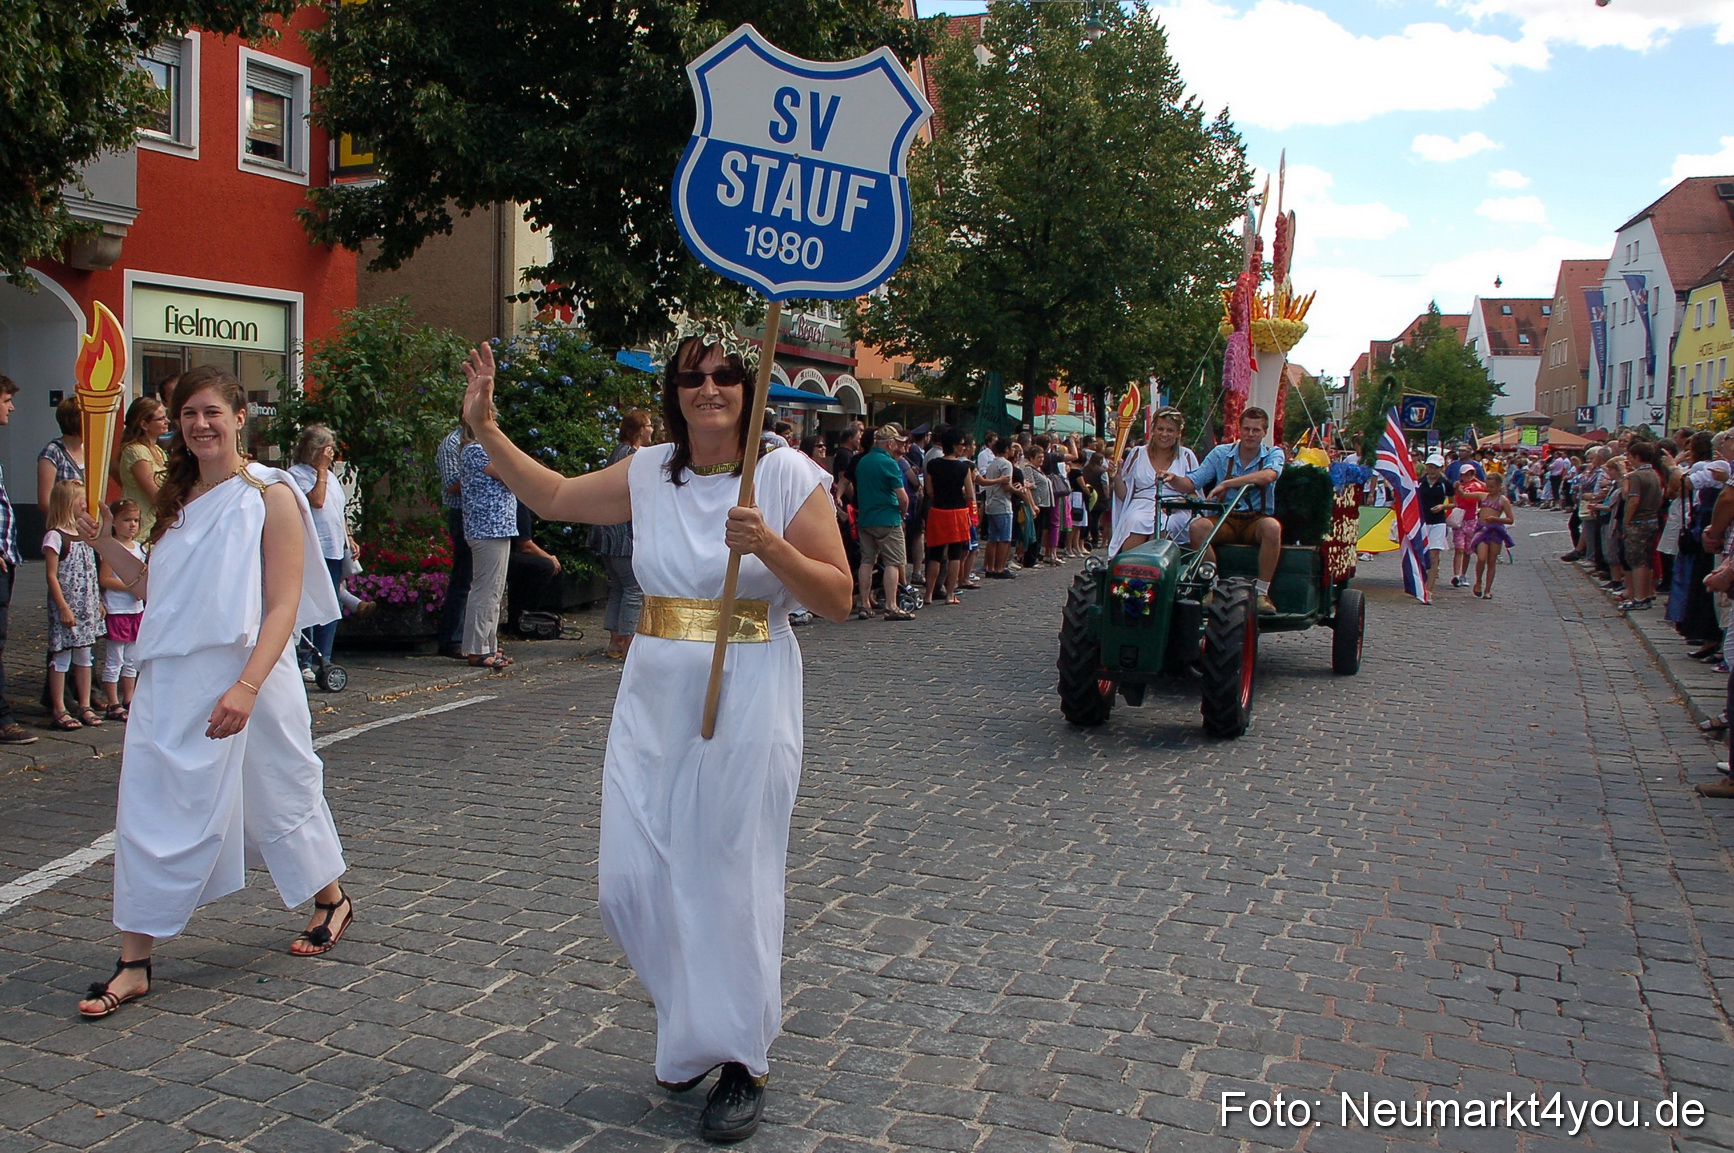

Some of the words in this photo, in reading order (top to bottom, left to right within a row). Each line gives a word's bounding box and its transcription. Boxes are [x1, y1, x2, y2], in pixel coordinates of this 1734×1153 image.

[768, 86, 842, 152] SV
[716, 150, 877, 233] STAUF
[744, 224, 824, 270] 1980
